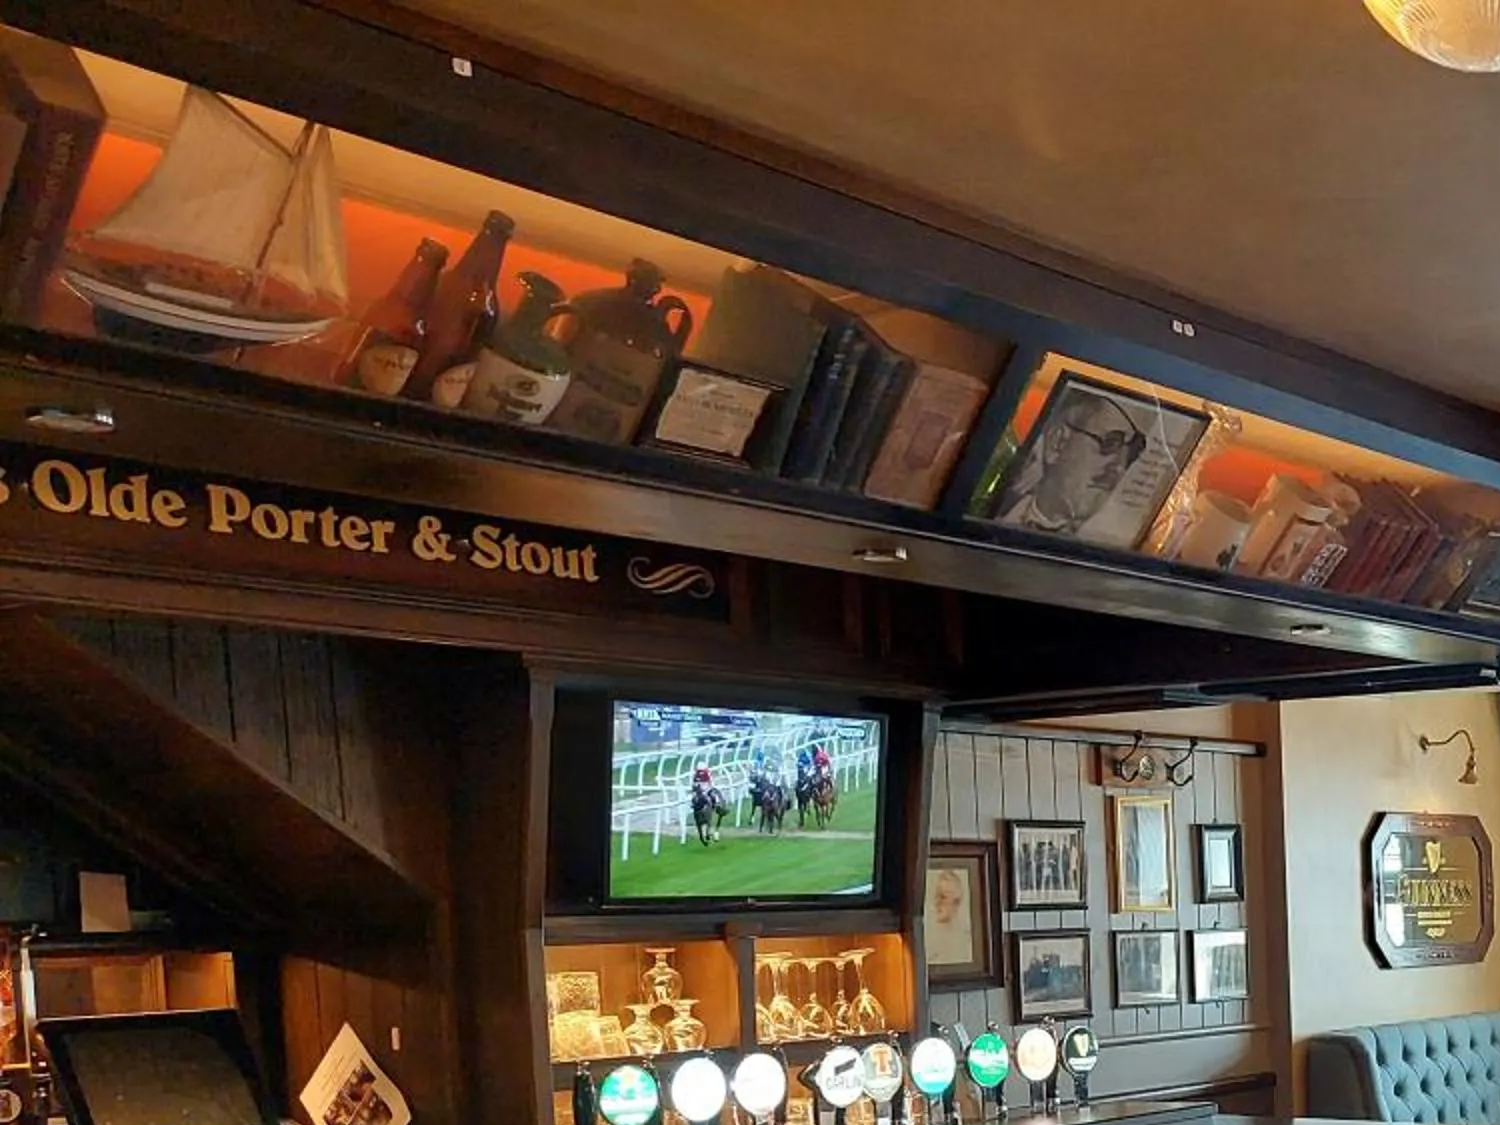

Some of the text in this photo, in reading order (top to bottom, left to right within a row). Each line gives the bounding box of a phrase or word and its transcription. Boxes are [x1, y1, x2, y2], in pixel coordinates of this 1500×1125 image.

[32, 459, 188, 528] Olde
[206, 483, 396, 553] Porter
[412, 515, 457, 562] &
[469, 523, 600, 583] Stout
